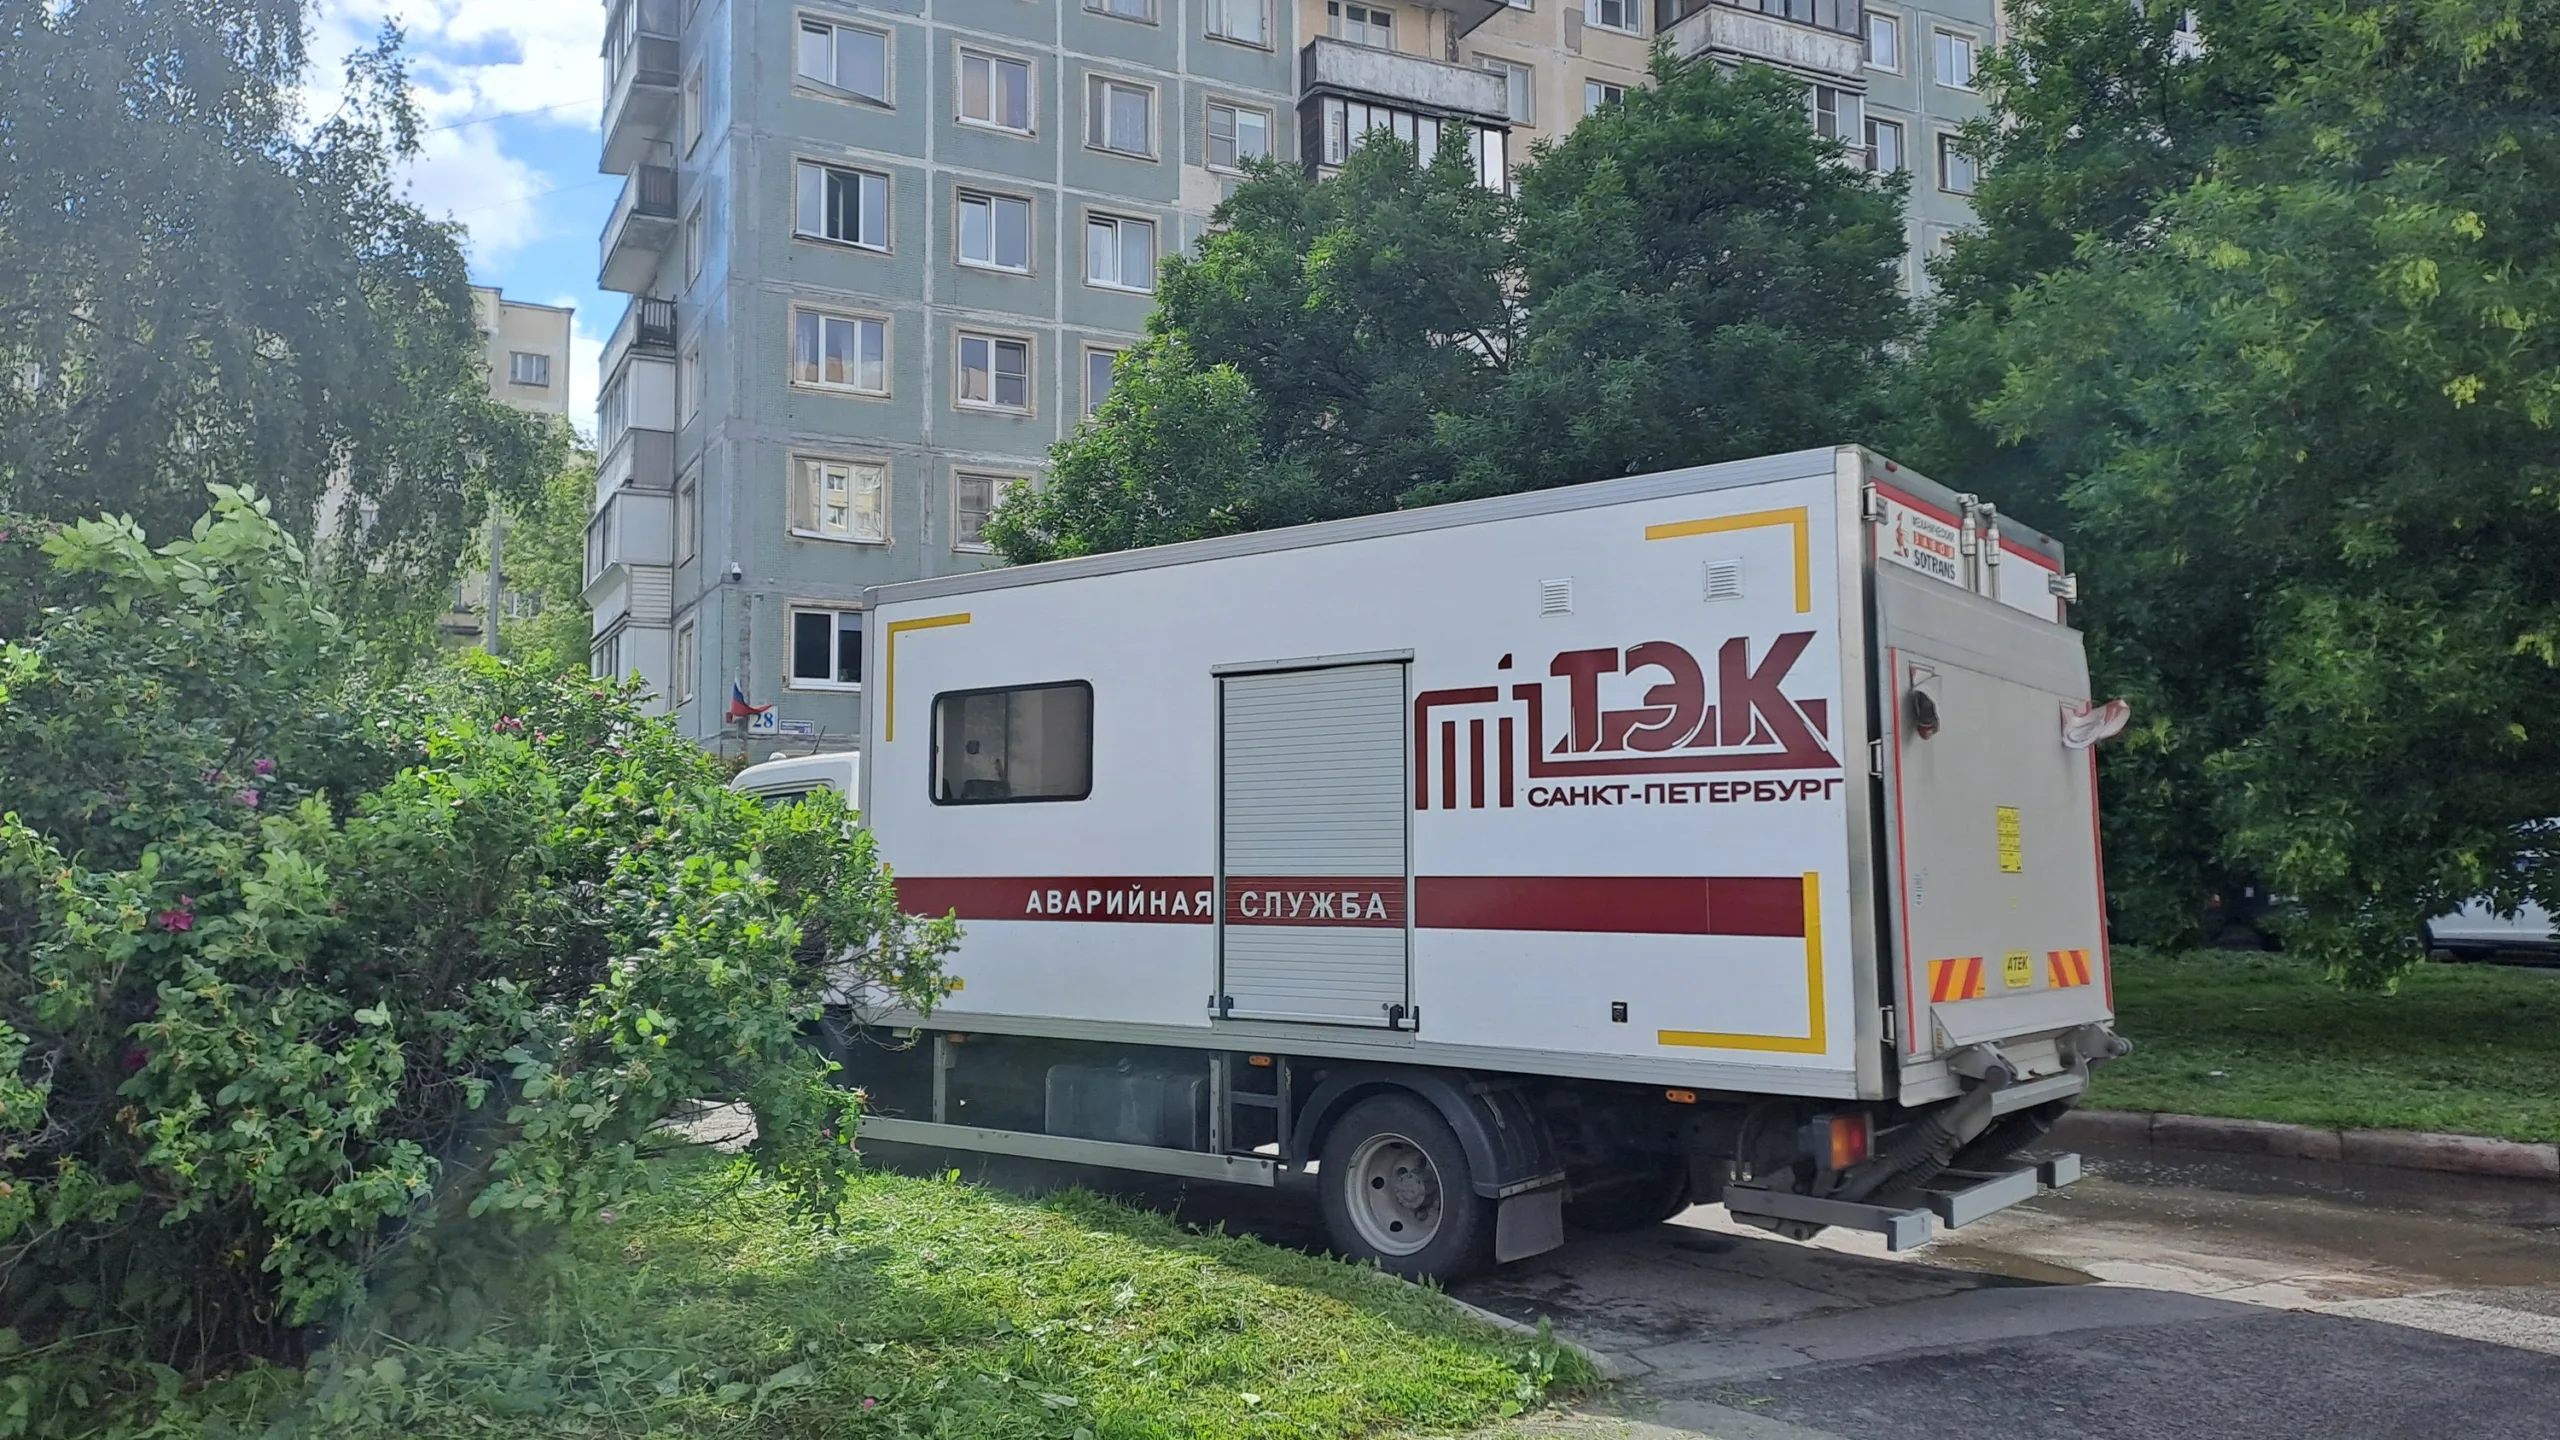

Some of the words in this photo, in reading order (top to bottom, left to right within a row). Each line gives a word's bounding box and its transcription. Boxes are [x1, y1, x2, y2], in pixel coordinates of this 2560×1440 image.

[1914, 549, 1956, 580] SOTRANS
[1550, 631, 1841, 768] ТЭК
[753, 712, 773, 728] 28
[1527, 778, 1844, 807] САНКТ-ПЕТЕРБУРГ
[1025, 884, 1212, 916] АВАРИЙНАЯ
[1239, 891, 1388, 919] СЛУЖБА
[2007, 956, 2028, 972] ATEK
